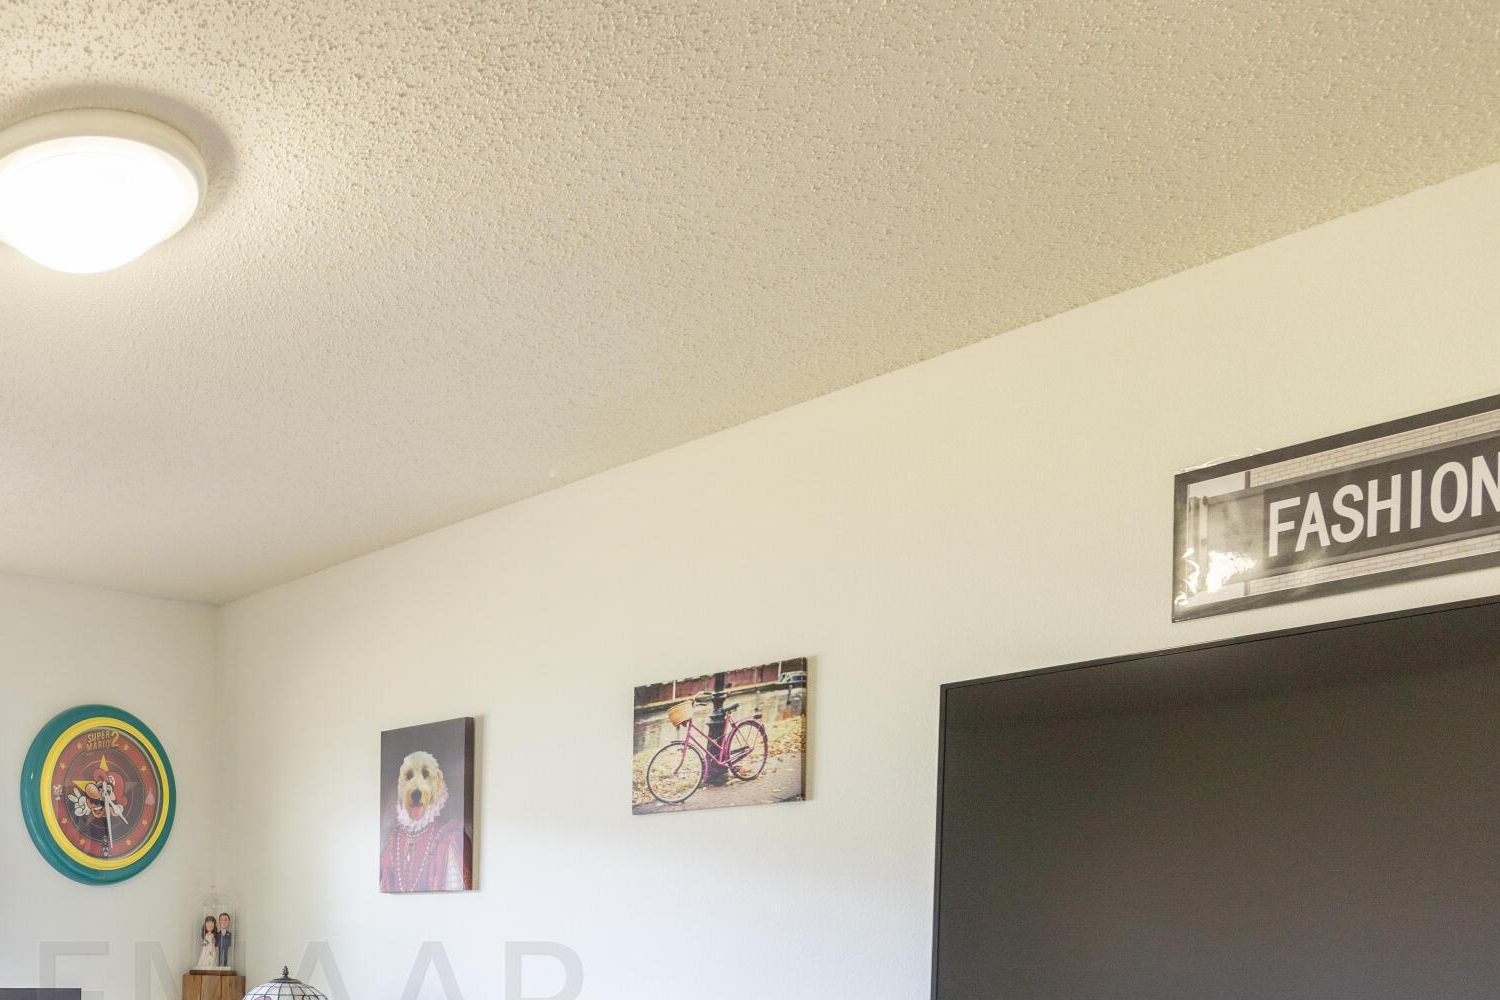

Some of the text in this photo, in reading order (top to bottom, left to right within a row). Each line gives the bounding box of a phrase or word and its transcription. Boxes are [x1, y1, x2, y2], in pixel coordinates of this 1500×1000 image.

[1268, 451, 1500, 557] FASHION
[87, 730, 110, 742] SUPER
[111, 730, 120, 748] 2
[86, 739, 110, 751] MARIO
